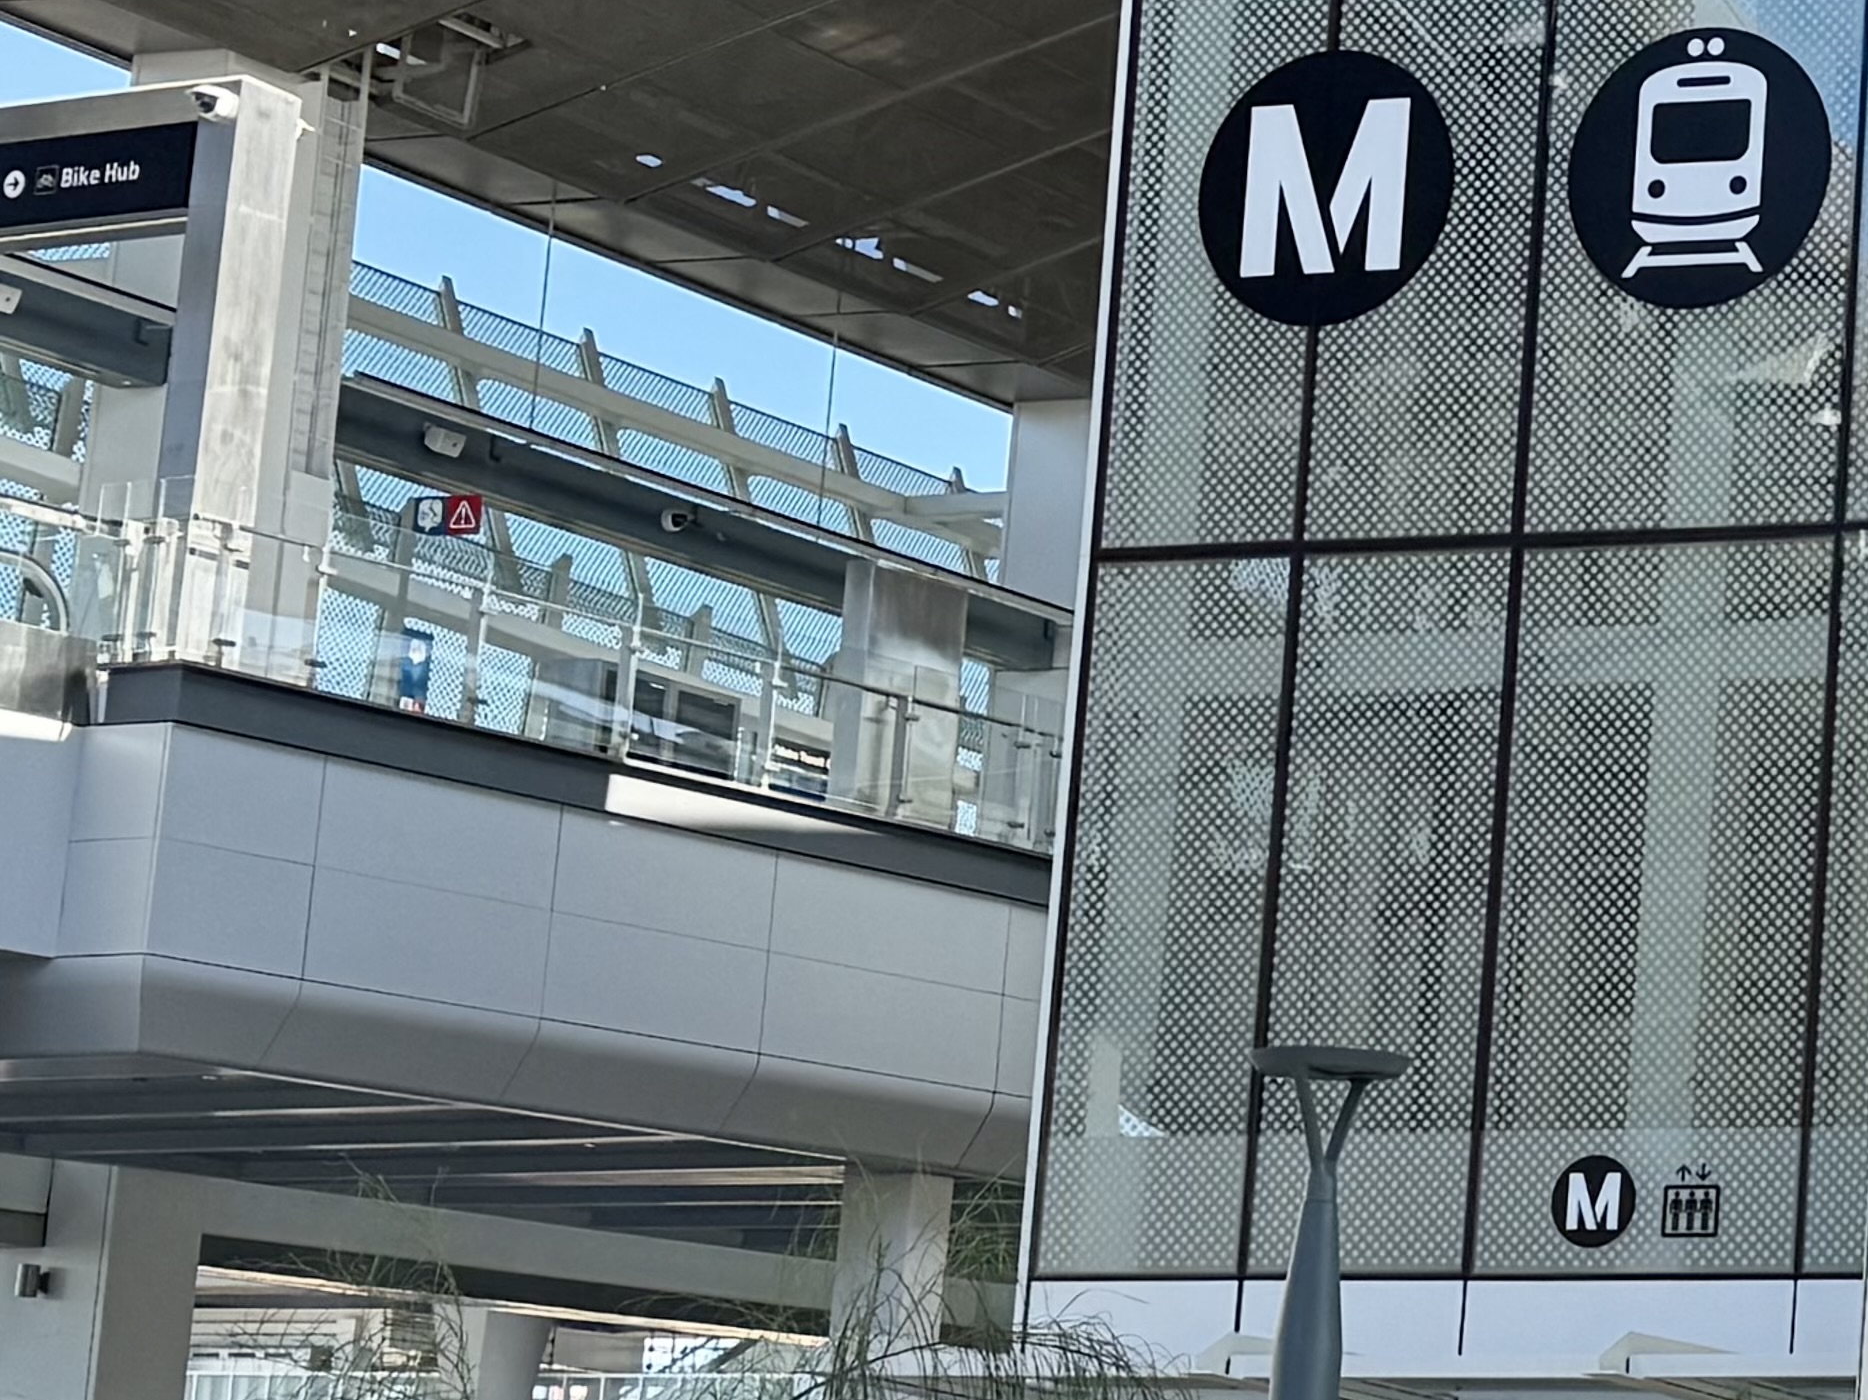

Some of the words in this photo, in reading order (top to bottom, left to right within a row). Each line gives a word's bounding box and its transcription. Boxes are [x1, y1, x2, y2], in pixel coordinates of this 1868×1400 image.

[60, 166, 101, 188] Bike
[104, 160, 140, 183] Hub
[1239, 95, 1412, 278] M
[1565, 1172, 1621, 1230] M
